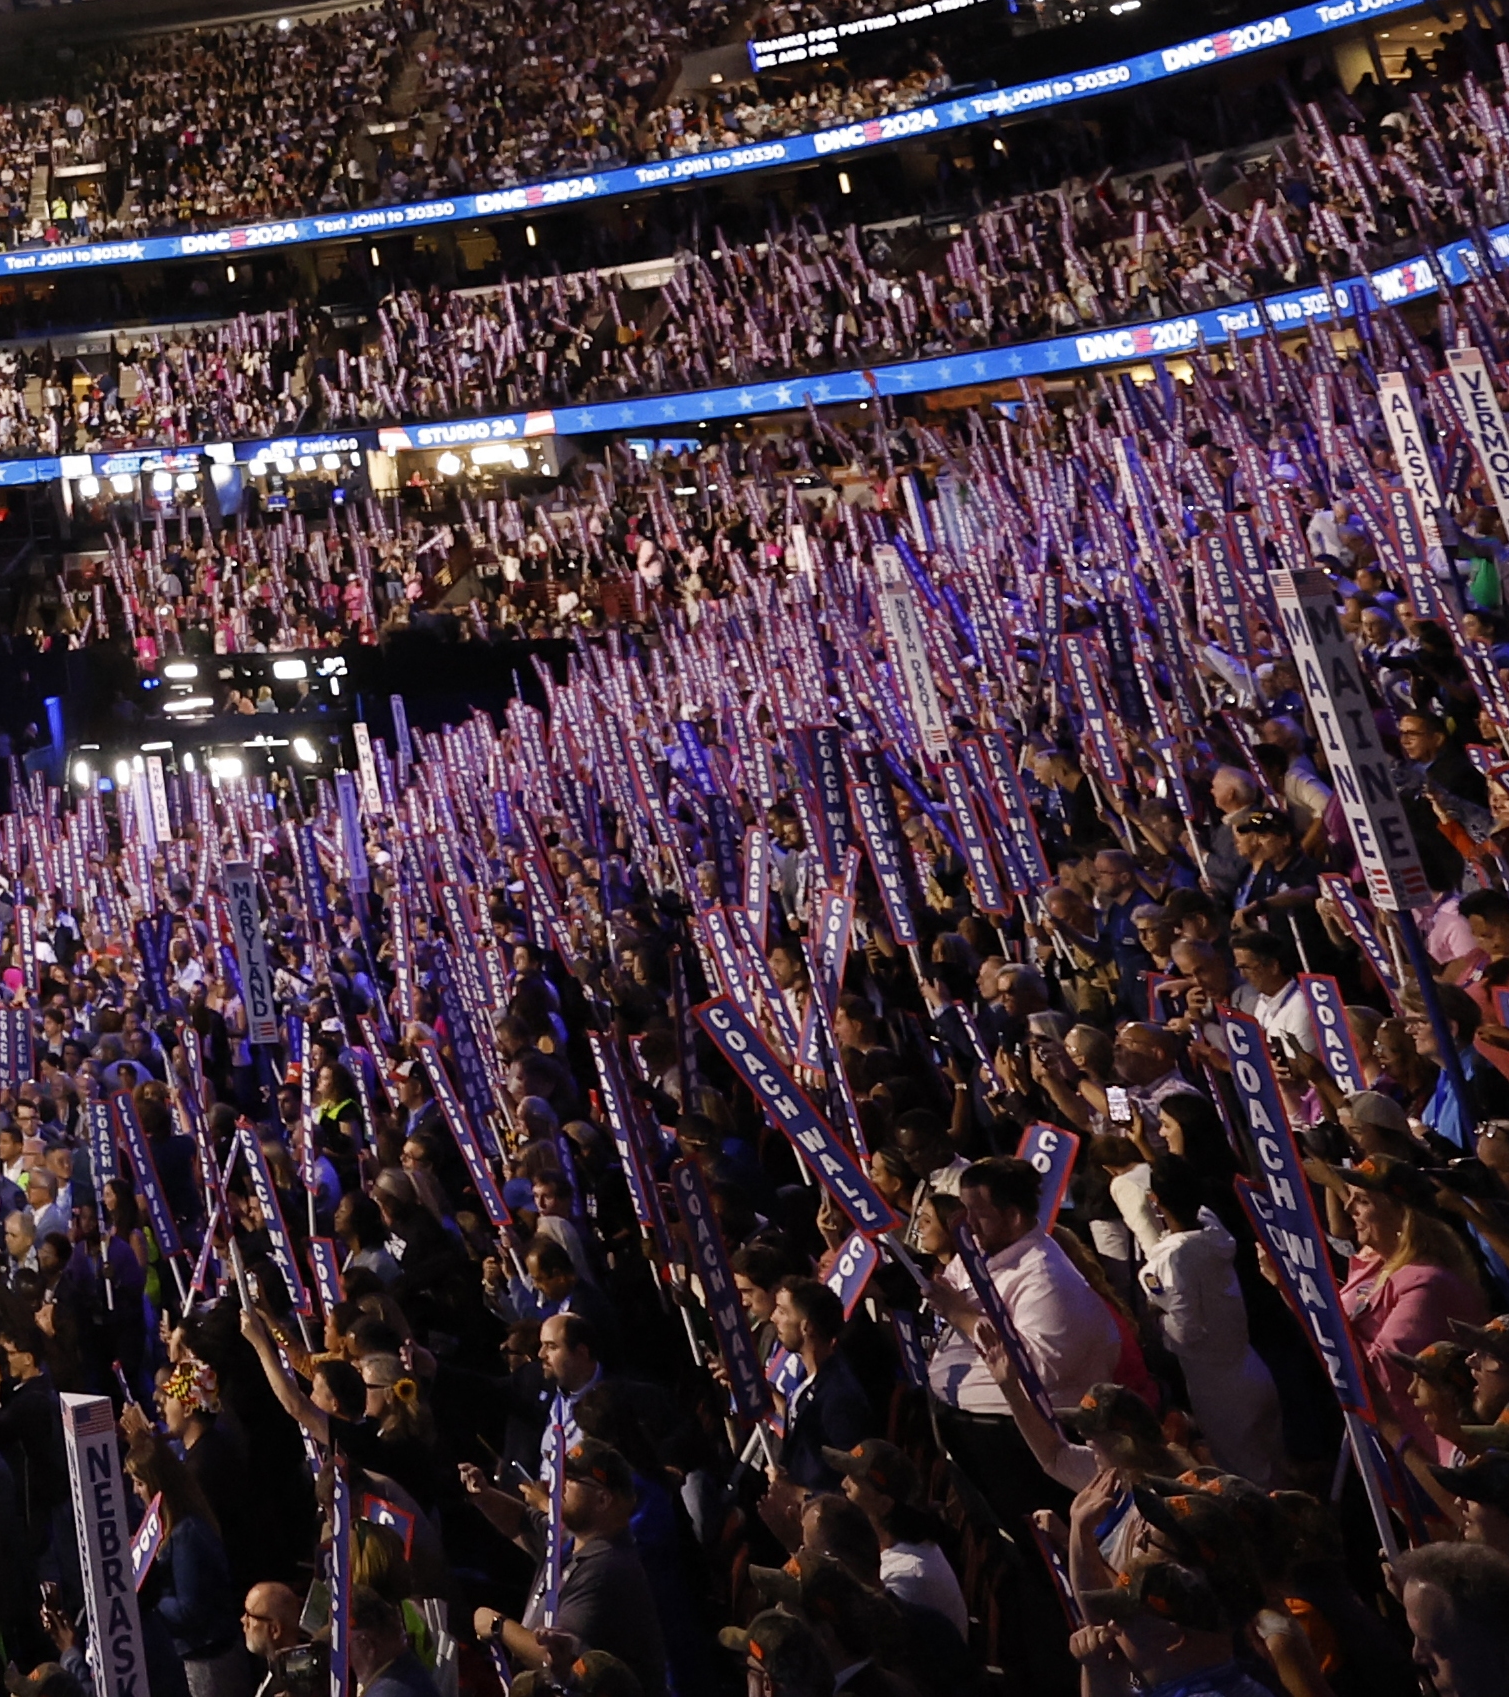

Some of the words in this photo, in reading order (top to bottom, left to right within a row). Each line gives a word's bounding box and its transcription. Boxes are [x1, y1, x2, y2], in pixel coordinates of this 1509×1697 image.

[753, 34, 807, 53] THANKS
[808, 27, 837, 44] FOR
[838, 14, 897, 36] PUTTING
[896, 5, 933, 24] YOUR
[778, 48, 807, 63] AND
[808, 42, 838, 57] FOR
[1162, 39, 1216, 71] DNC
[1230, 17, 1292, 51] 2024
[1315, 1, 1355, 23] Text
[301, 438, 359, 454] CHICAGO
[417, 425, 490, 444] STUDIO
[492, 419, 517, 437] 24
[1391, 394, 1434, 521] ALASKA
[1392, 492, 1417, 556] COACH
[1406, 563, 1430, 614] WALZ
[358, 734, 377, 800] OHIO
[1066, 638, 1095, 710] COACH
[1091, 718, 1115, 777] WALZ
[1282, 606, 1377, 858] MAINE
[1308, 605, 1411, 858] MAINE
[152, 767, 163, 791] NEW
[233, 881, 268, 1017] MARYLAND
[709, 1008, 799, 1119] COACH
[795, 1127, 877, 1222] WALZ
[1225, 1021, 1297, 1211] COACH
